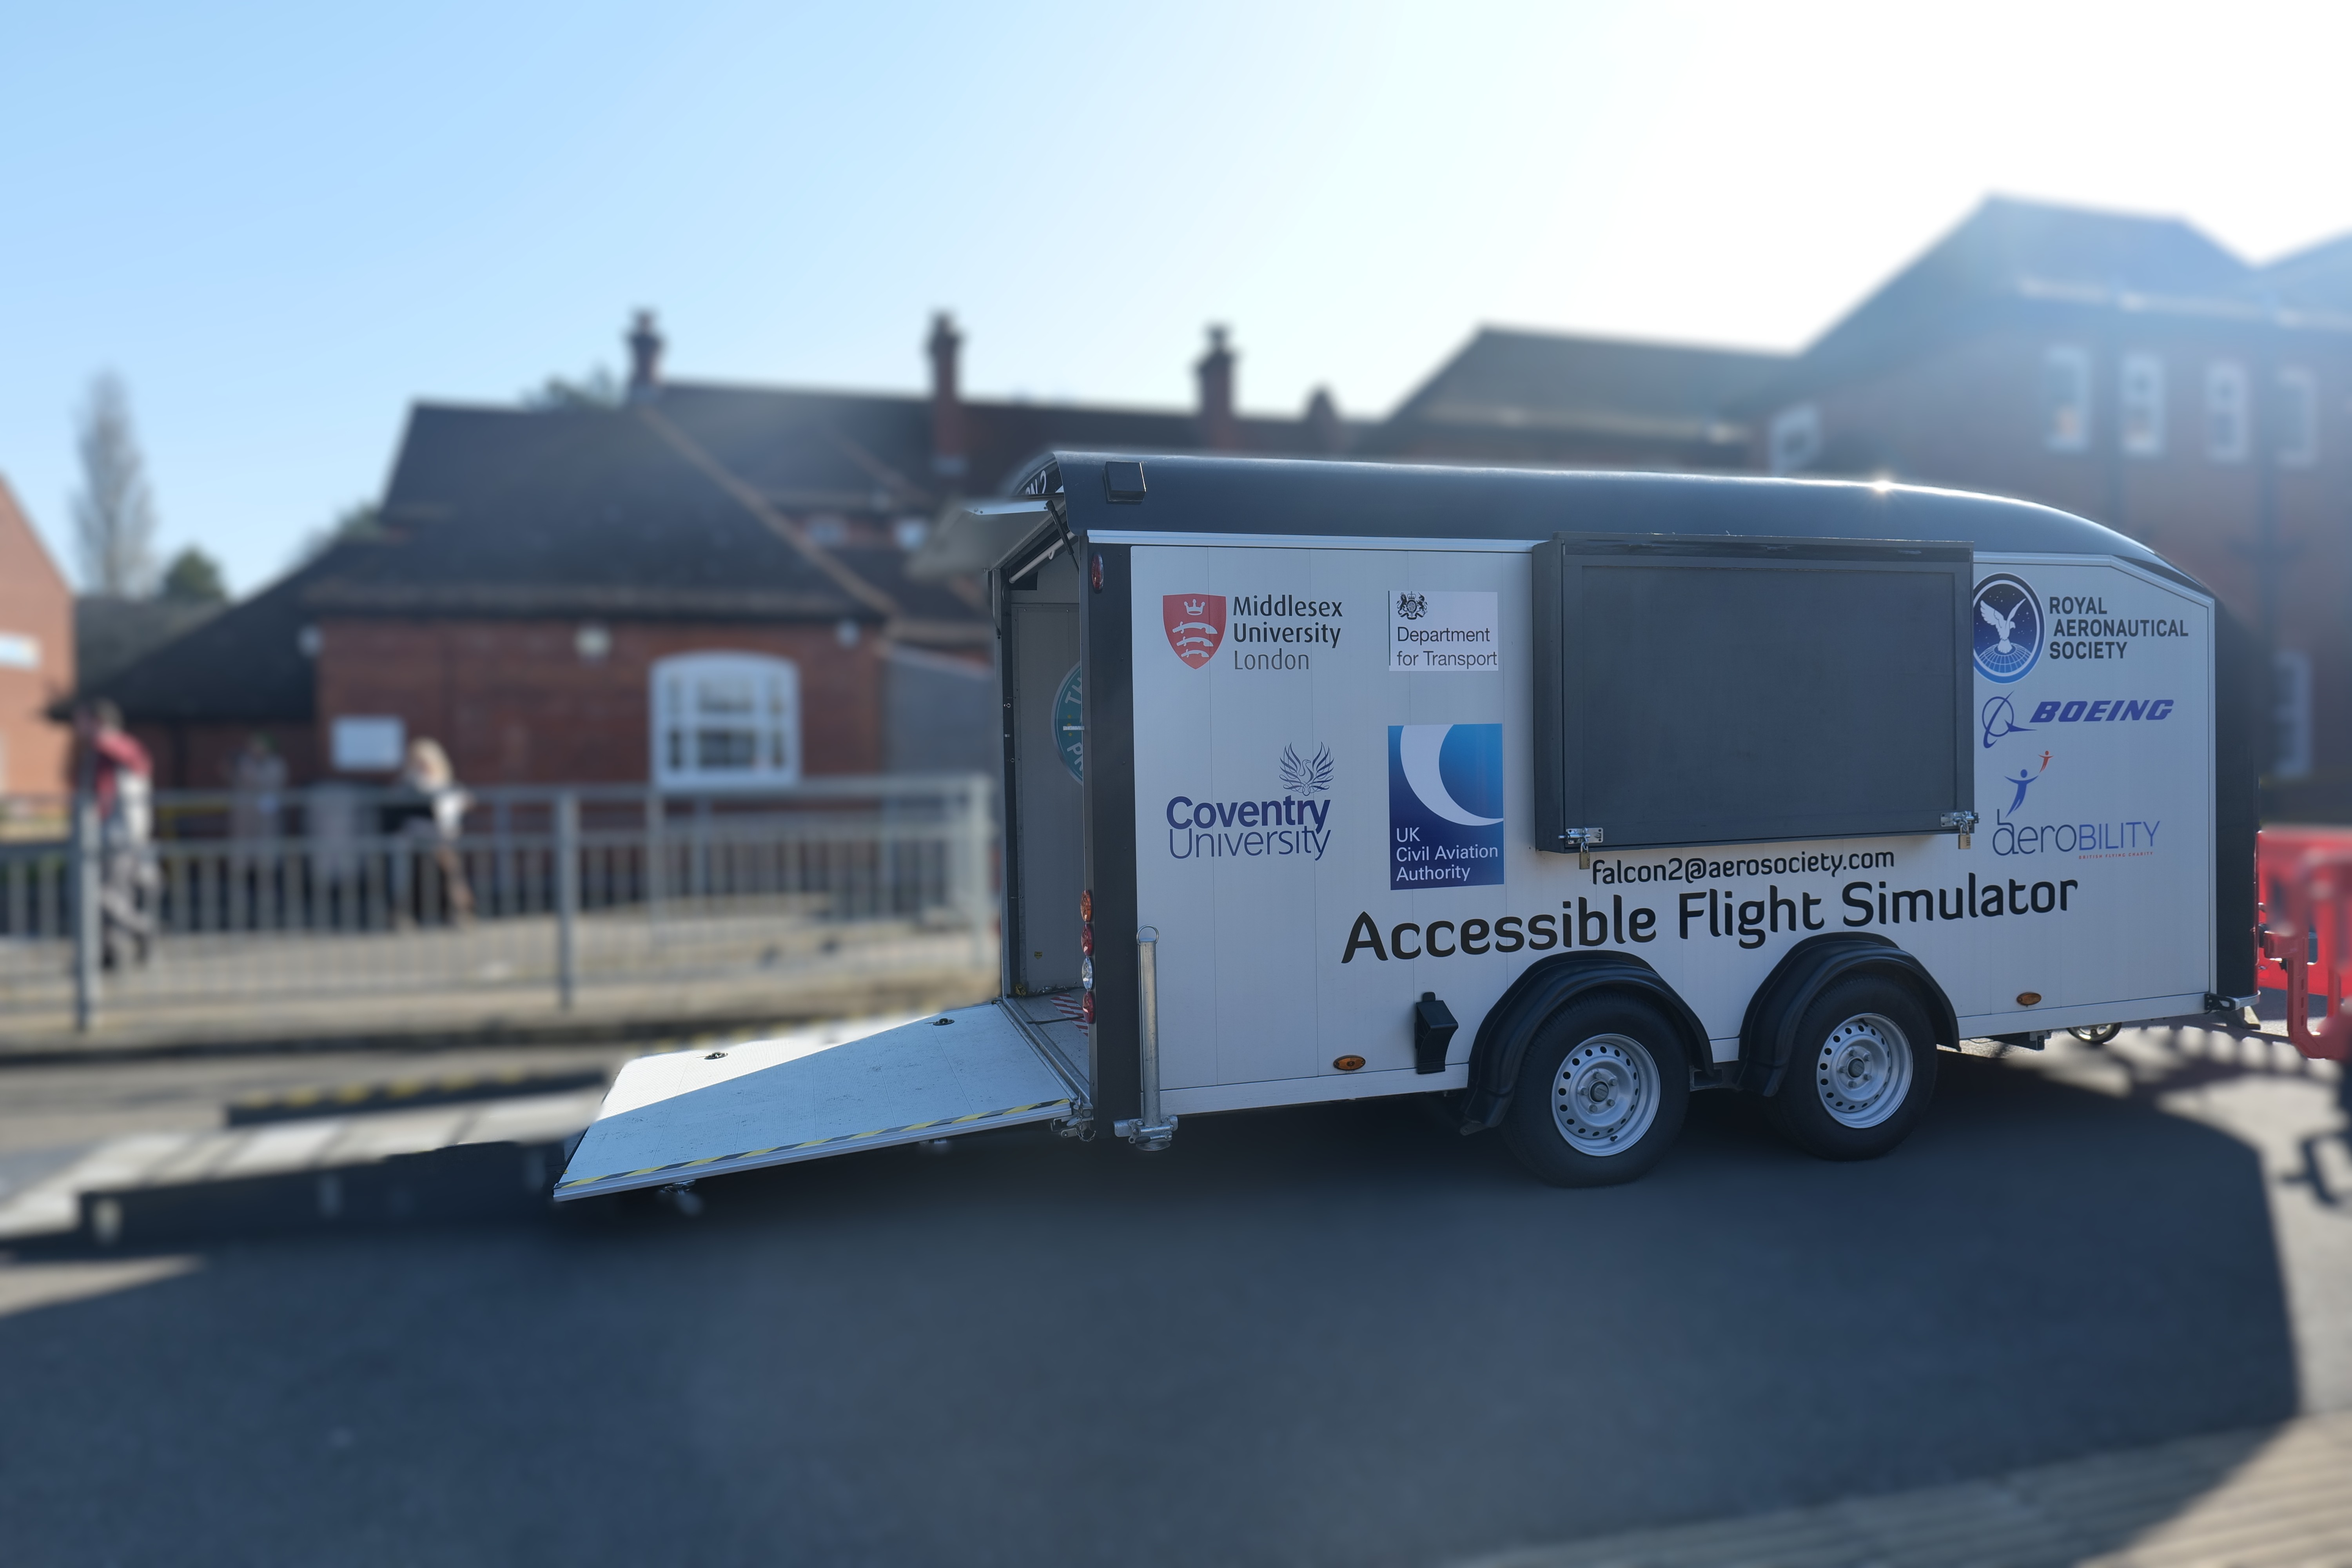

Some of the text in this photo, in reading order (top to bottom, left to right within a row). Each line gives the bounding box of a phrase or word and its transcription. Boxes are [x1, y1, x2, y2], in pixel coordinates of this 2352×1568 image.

[1234, 594, 1343, 617] Middlesex
[2050, 596, 2107, 614] ROYAL
[1234, 622, 1341, 648] University
[1397, 626, 1490, 646] Department
[2054, 619, 2189, 637] AERONAUTICAL
[1235, 648, 1309, 670] London
[1397, 651, 1497, 669] for Transport
[2049, 641, 2127, 659] SOCIETY
[2029, 699, 2174, 723] BOEING
[1166, 795, 1331, 834] Coventry
[1169, 825, 1331, 861] University
[1397, 827, 1421, 842] UK
[1396, 844, 1498, 862] Civil Aviation
[1396, 864, 1470, 882] Authority
[1593, 851, 1894, 884] falcon2@aerosociety.com
[1341, 873, 2078, 964] Accessible Flight Simulator
